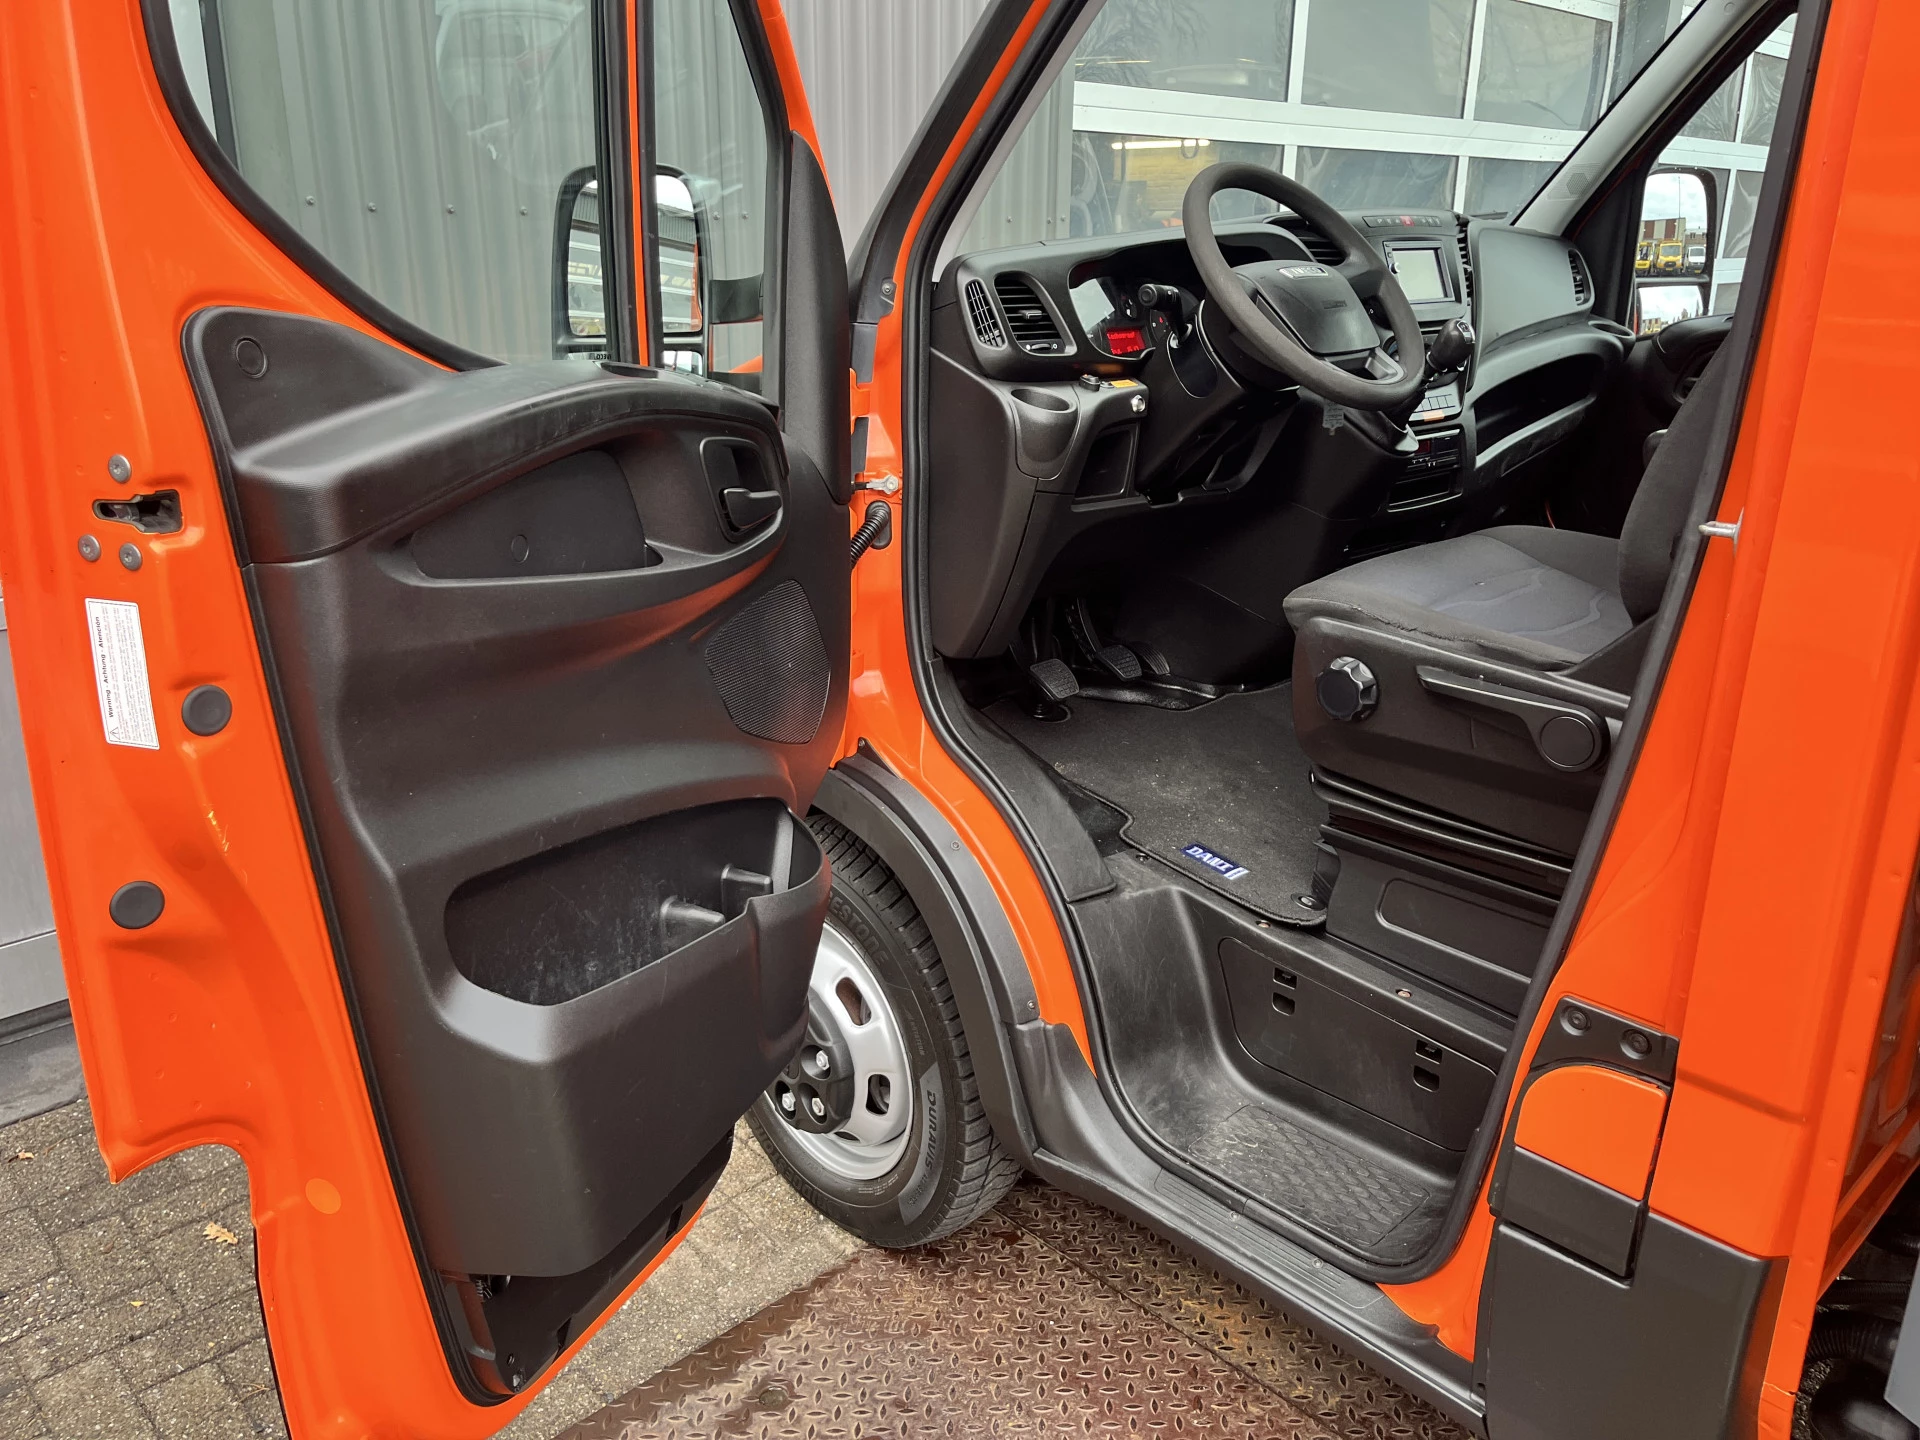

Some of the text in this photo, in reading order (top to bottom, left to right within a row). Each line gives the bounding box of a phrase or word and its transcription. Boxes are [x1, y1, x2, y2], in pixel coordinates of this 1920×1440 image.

[96, 616, 114, 718] Warning Achtung Atención
[828, 895, 889, 968] ESTONE
[925, 1088, 937, 1170] DURAVIS
